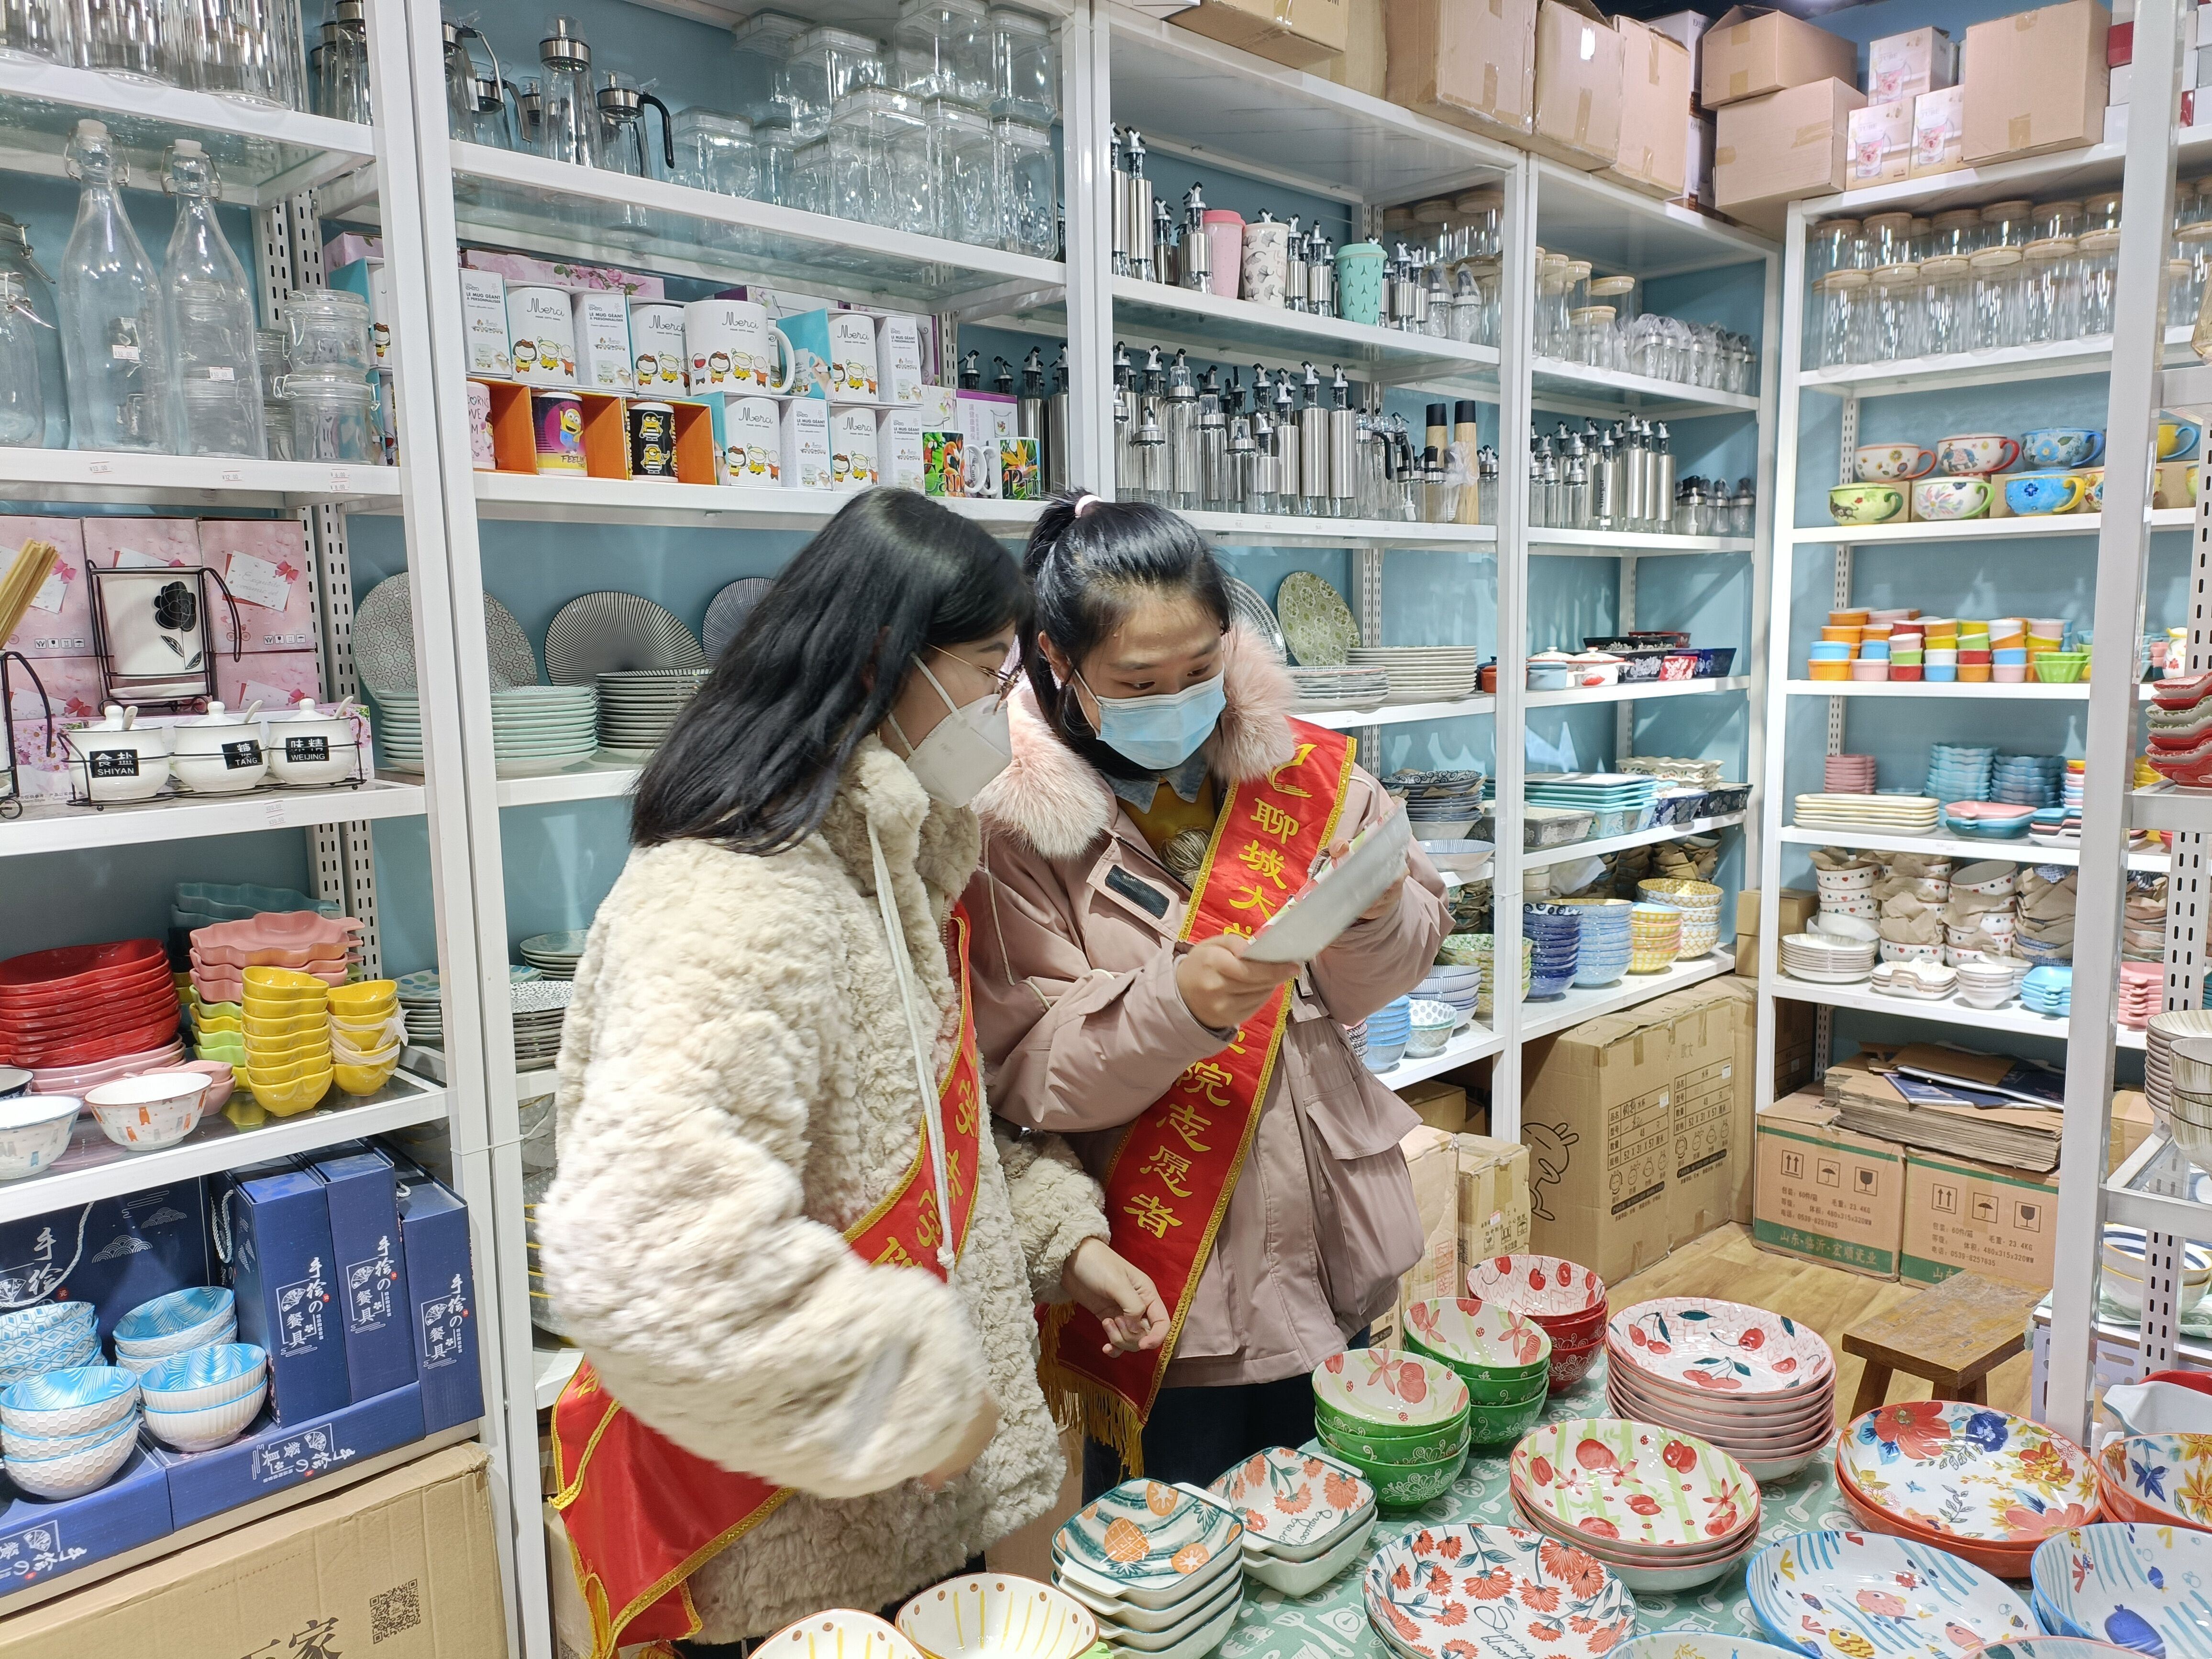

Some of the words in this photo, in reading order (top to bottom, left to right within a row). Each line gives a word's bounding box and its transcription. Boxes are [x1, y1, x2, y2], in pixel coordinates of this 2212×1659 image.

[527, 298, 564, 317] Merci
[649, 315, 686, 332] Merci
[722, 311, 759, 329] Merci
[837, 325, 869, 341] Merci
[738, 407, 773, 424] Merci
[843, 417, 873, 431] Merci
[236, 743, 253, 757] 糖
[290, 738, 324, 752] 味精
[96, 752, 134, 766] 食盐
[291, 752, 326, 761] WEIJING
[97, 767, 134, 775] SHIYAN
[1676, 1080, 1684, 1089] 品名
[1676, 1093, 1684, 1104] 型号
[1676, 1107, 1684, 1117] 数量
[1703, 1096, 1708, 1106] 48
[1610, 1111, 1619, 1121] 品名
[1676, 1122, 1684, 1132] 规格
[1689, 1117, 1694, 1127] 52
[1700, 1112, 1705, 1121] 31
[1712, 1107, 1717, 1117] 57
[1123, 1031, 1246, 1239] 院志愿者
[1610, 1125, 1619, 1136] 型号
[1610, 1140, 1619, 1151] 数量
[1640, 1128, 1645, 1137] 48
[1610, 1156, 1619, 1166] 规格
[1624, 1150, 1630, 1161] 52
[1637, 1144, 1642, 1154] 31
[1648, 1138, 1654, 1148] 57
[356, 1289, 376, 1325] 餐具
[287, 1312, 307, 1349] 餐具
[429, 1326, 447, 1361] 餐具
[262, 1442, 301, 1466] 餐具
